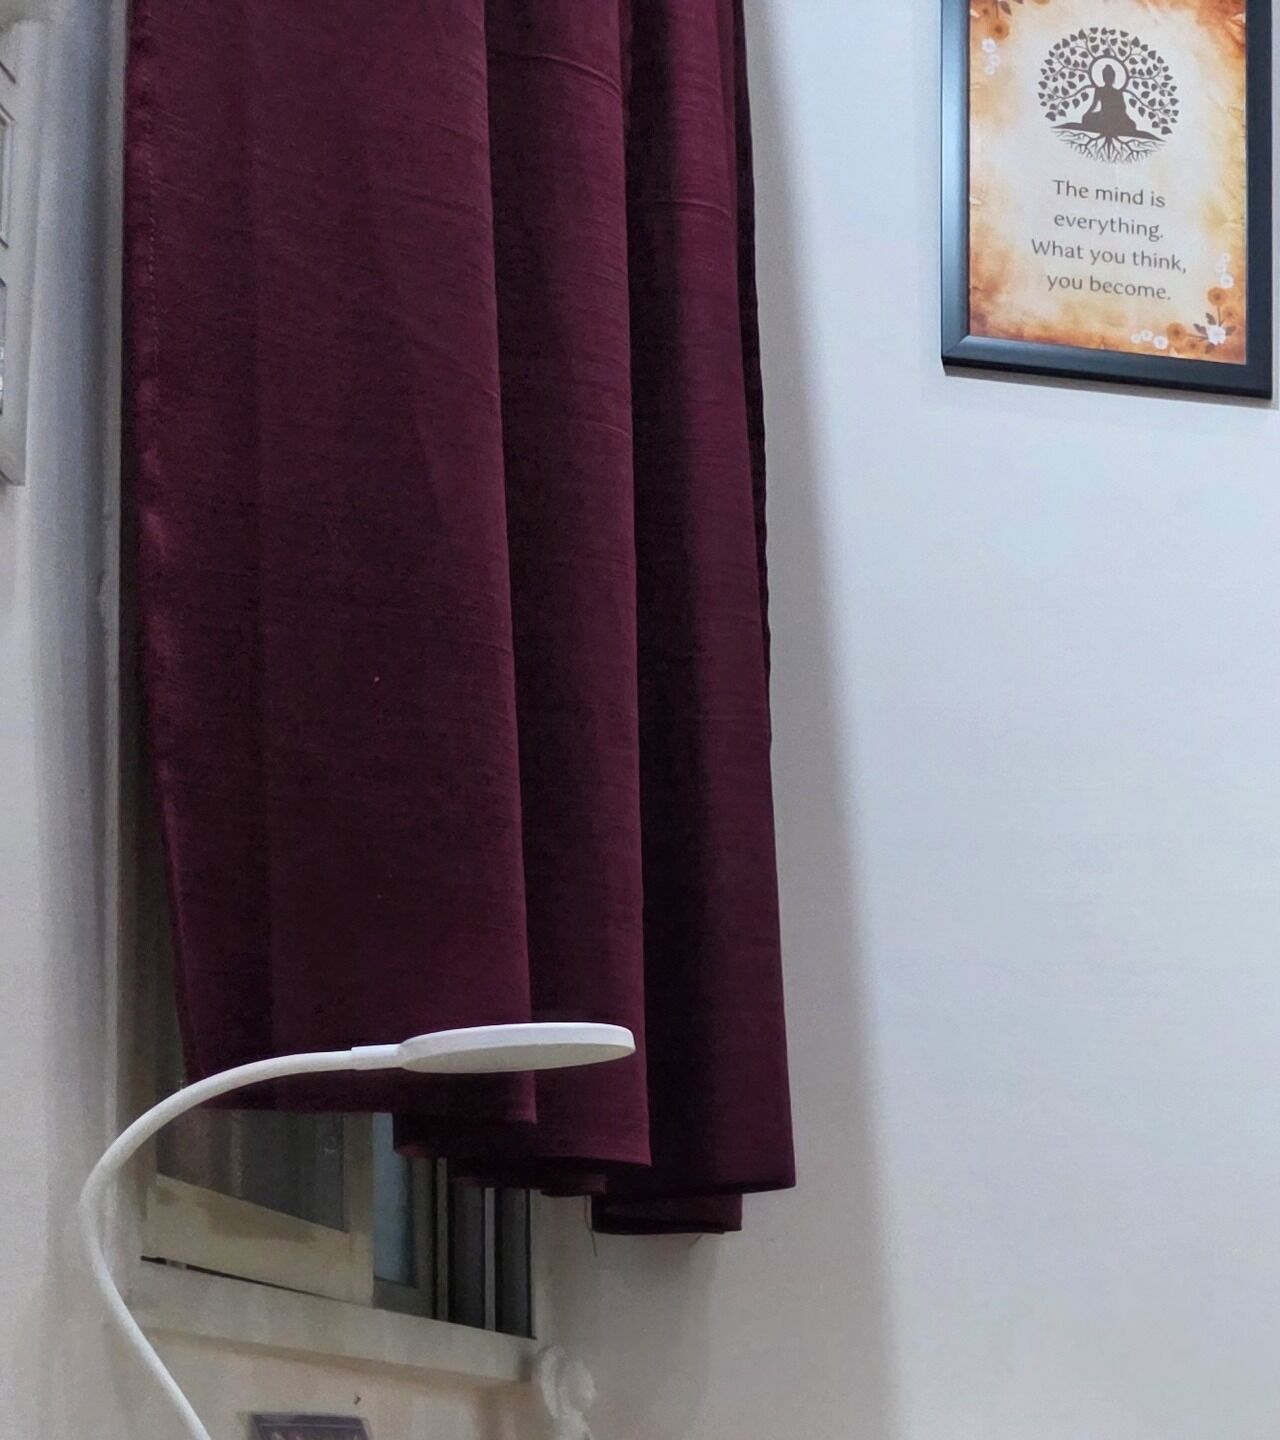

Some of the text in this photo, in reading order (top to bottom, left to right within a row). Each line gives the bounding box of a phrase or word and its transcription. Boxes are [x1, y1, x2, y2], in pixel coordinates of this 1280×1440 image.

[1052, 179, 1166, 208] The mind is
[1054, 213, 1164, 242] everything.
[1031, 238, 1187, 274] What you think,
[1047, 274, 1172, 300] you become.
